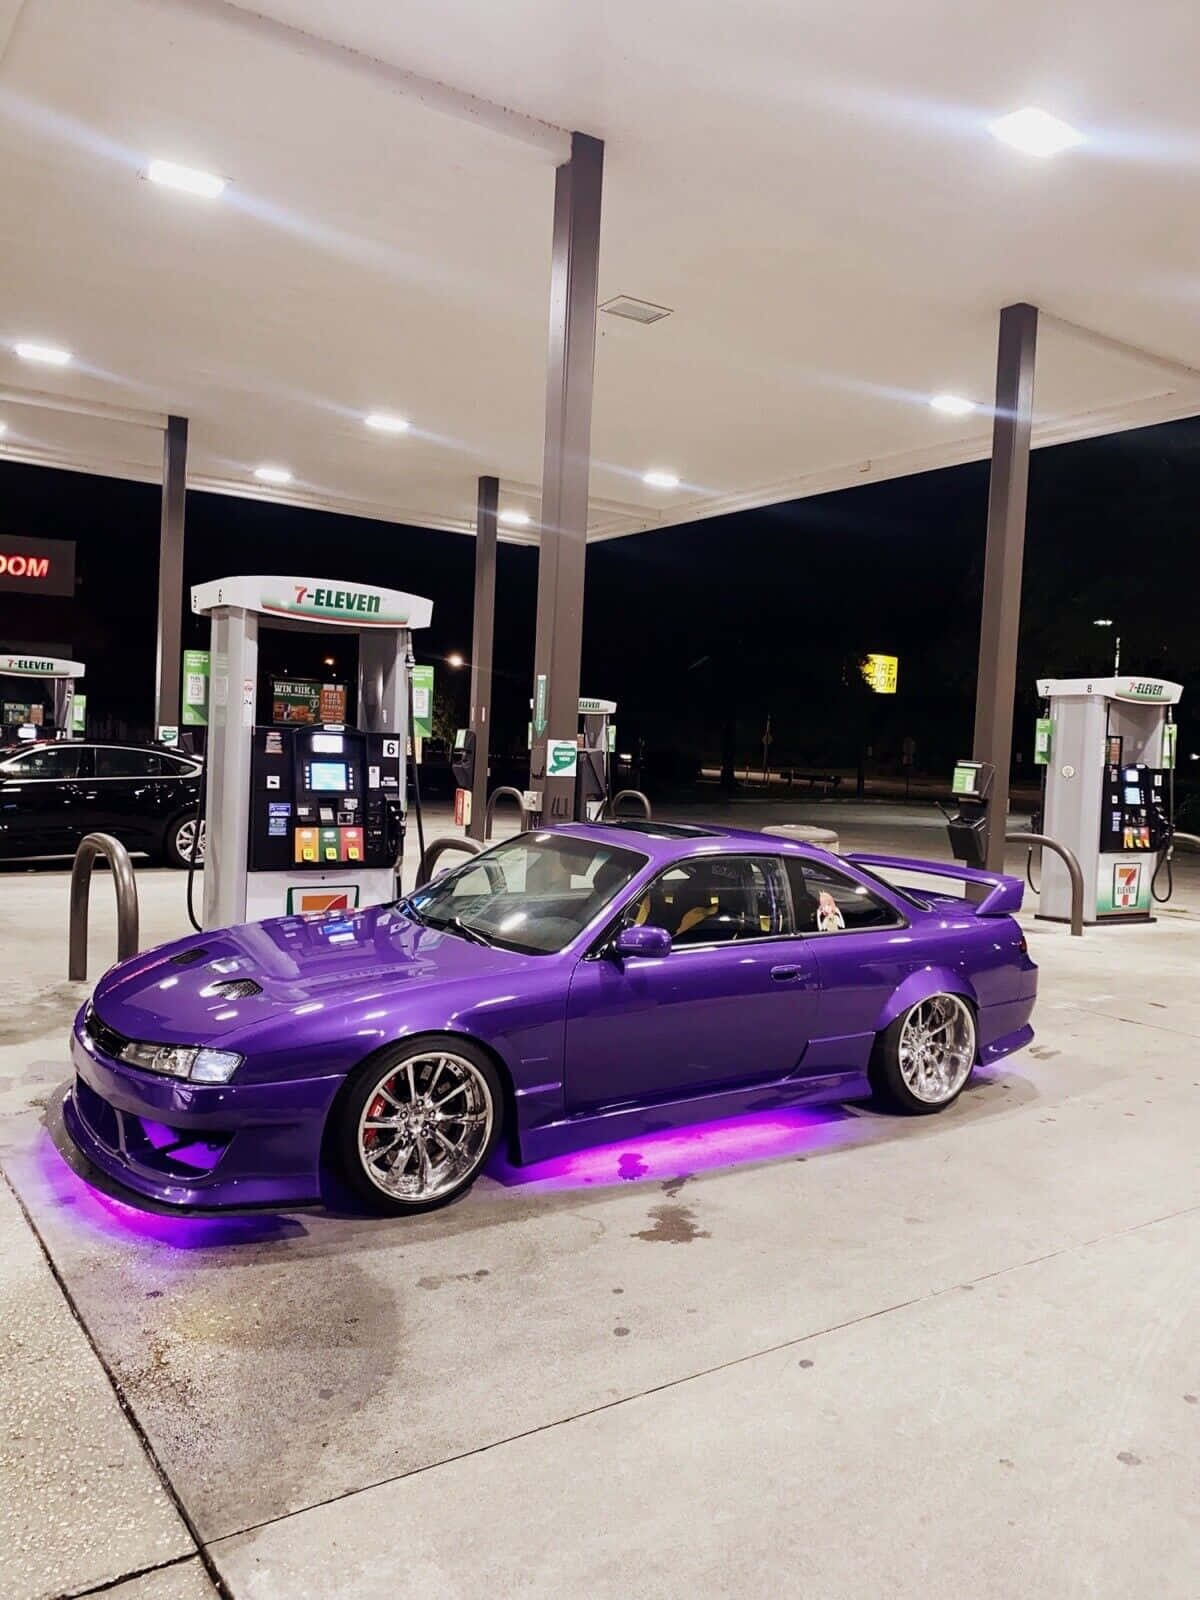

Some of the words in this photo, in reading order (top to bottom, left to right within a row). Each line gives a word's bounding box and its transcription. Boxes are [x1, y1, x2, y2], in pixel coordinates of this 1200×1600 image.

[294, 586, 380, 613] 7-ELEVEN
[7, 659, 54, 671] 7-ELEVEN
[1044, 685, 1050, 695] 7
[1128, 682, 1164, 696] 7-ELEVEN
[387, 742, 395, 756] 6
